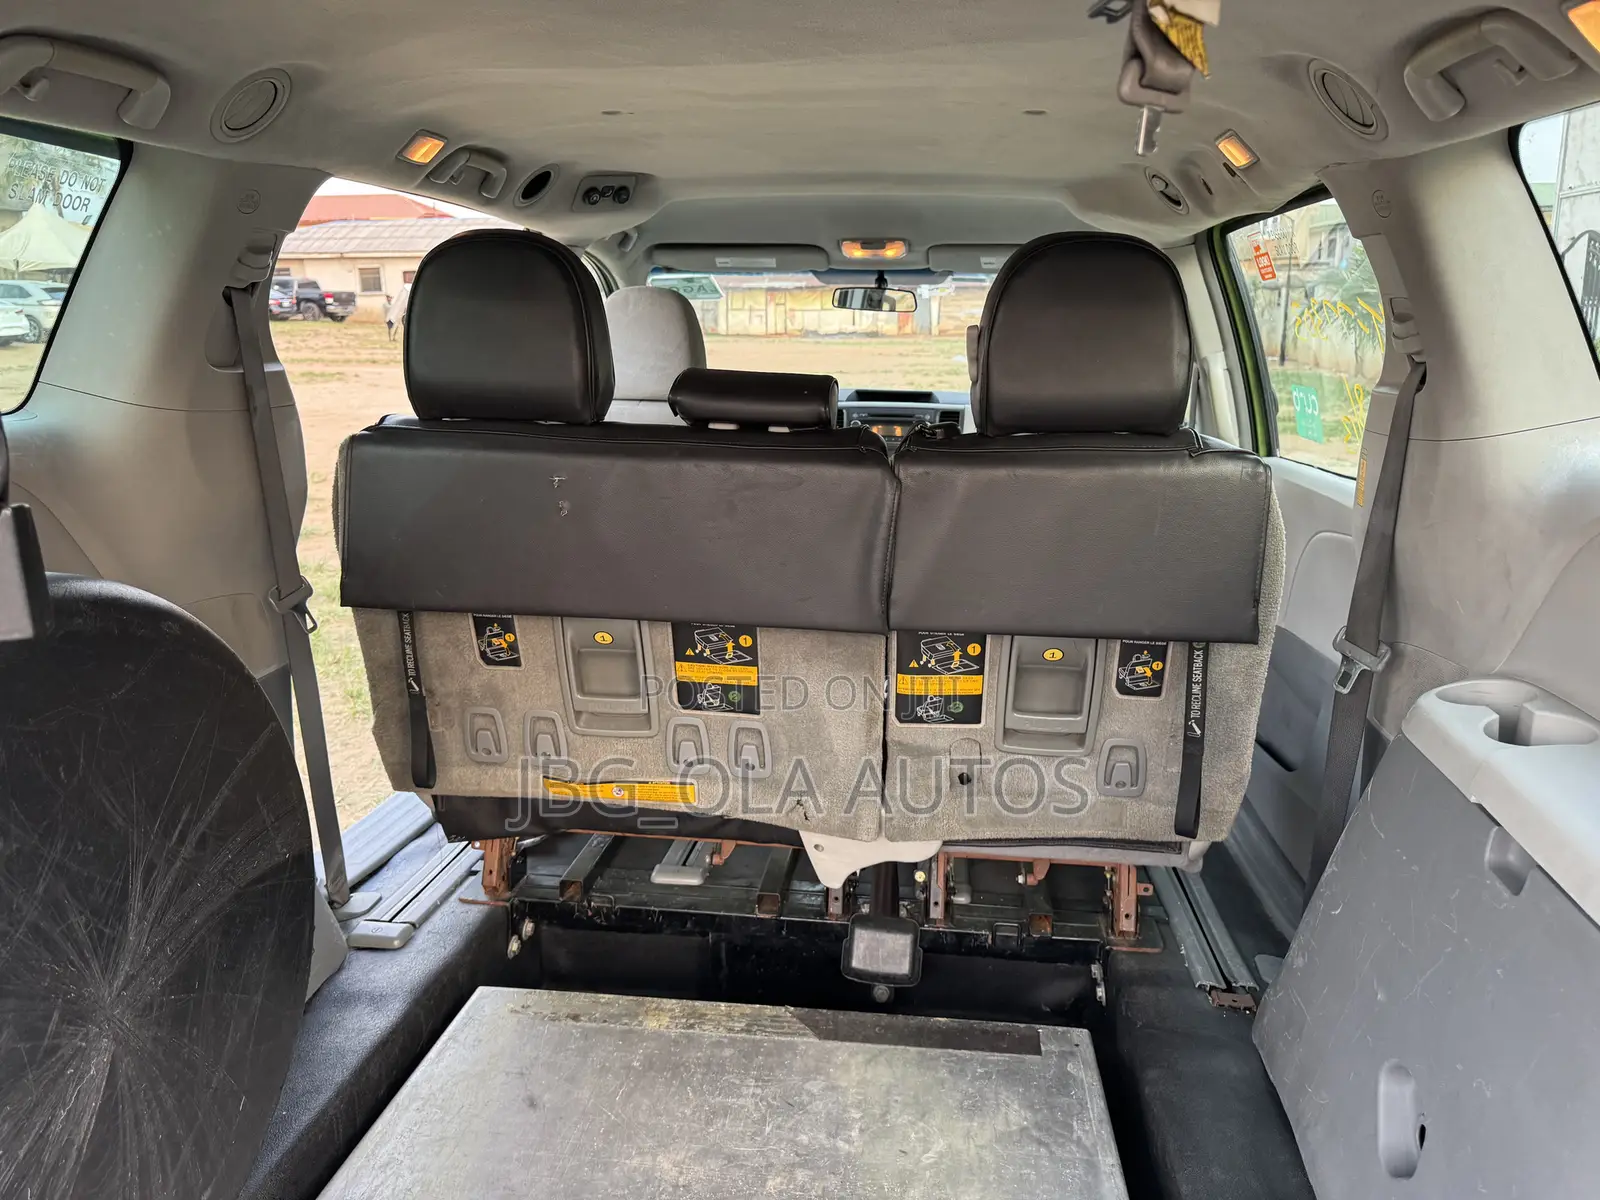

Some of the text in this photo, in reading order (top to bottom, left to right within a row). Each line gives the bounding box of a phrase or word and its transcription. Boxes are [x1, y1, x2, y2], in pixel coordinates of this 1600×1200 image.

[8, 157, 106, 193] PLEASE DO NOT
[8, 182, 91, 213] SLAM DOOR
[408, 669, 416, 677] TO
[1190, 649, 1204, 718] TO RECLINE SEATBACK
